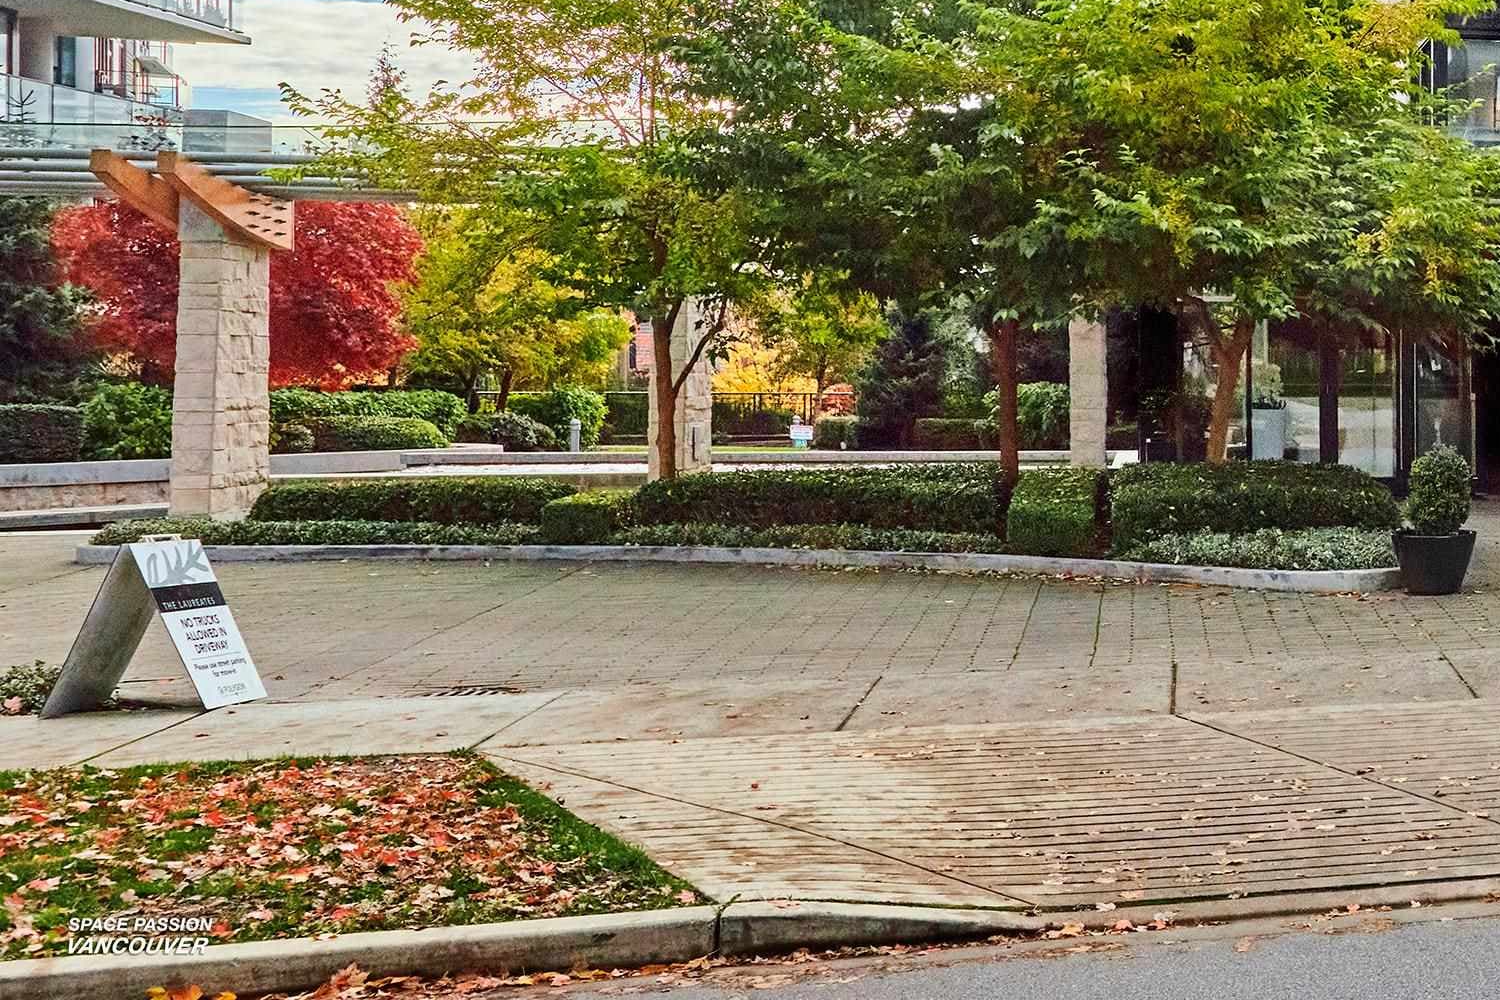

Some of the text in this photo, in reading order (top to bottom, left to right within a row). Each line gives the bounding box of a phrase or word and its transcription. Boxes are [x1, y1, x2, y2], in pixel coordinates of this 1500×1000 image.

[161, 597, 216, 610] THE LAUREATES
[180, 614, 221, 628] NO TRUCKS
[185, 626, 228, 641] ALLOWED IN
[194, 640, 229, 654] DRIVEWAY
